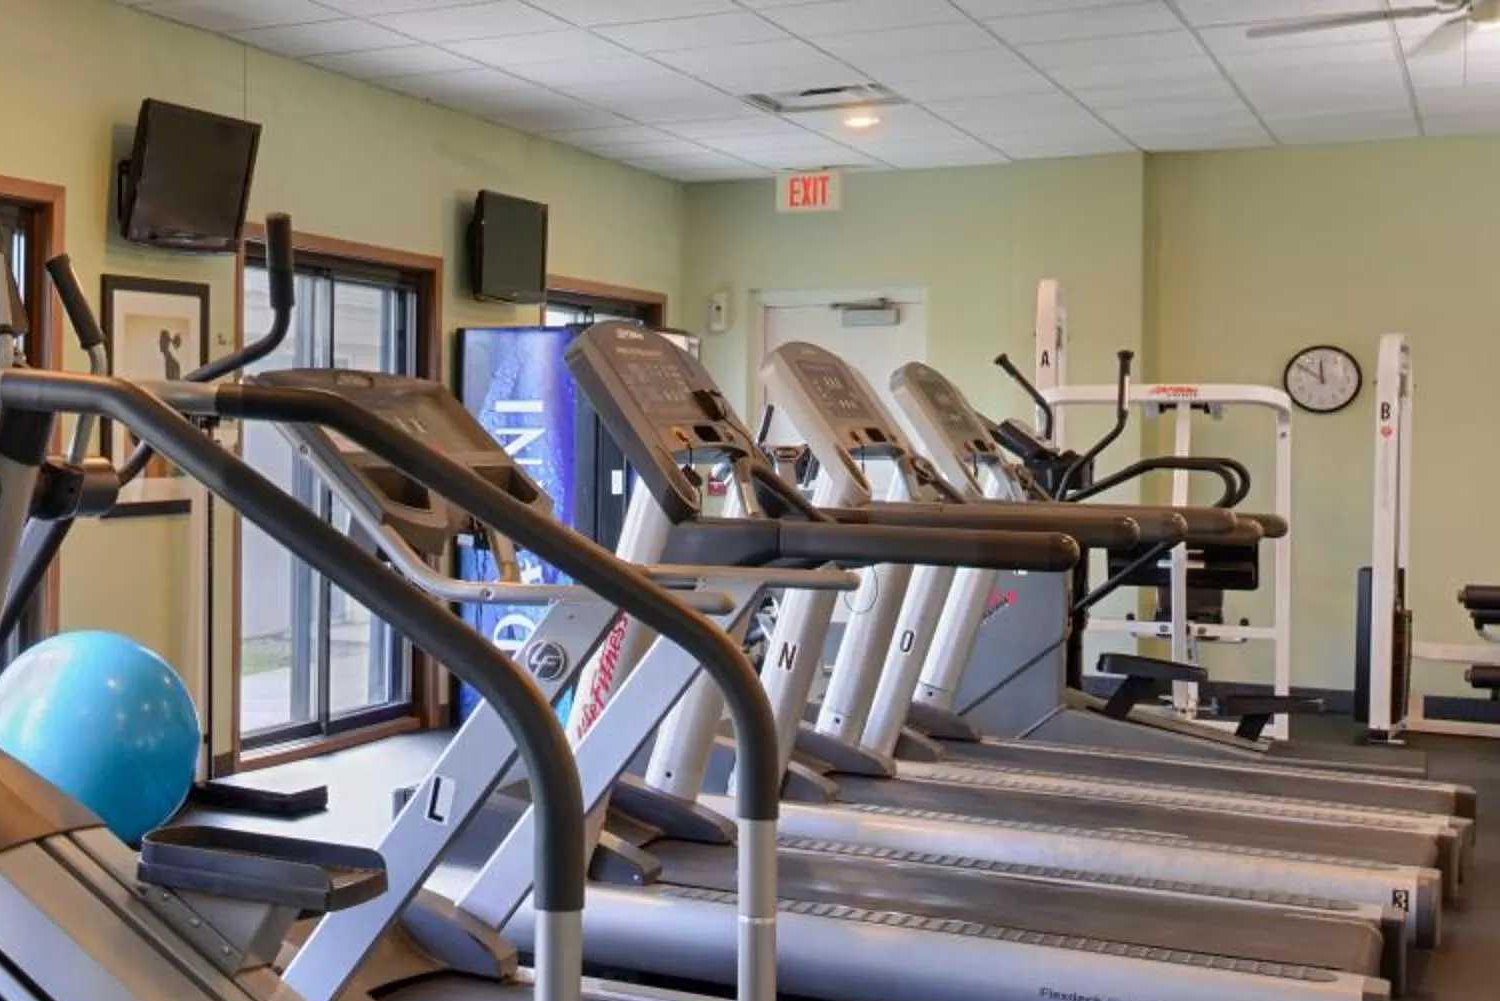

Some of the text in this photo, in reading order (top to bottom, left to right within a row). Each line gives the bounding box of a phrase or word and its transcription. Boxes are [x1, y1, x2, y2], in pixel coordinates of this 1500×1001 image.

[789, 175, 829, 207] EXIT
[1041, 350, 1051, 367] A
[1381, 401, 1391, 420] B
[778, 641, 796, 670] N
[427, 776, 445, 823] L
[1394, 890, 1407, 910] 3
